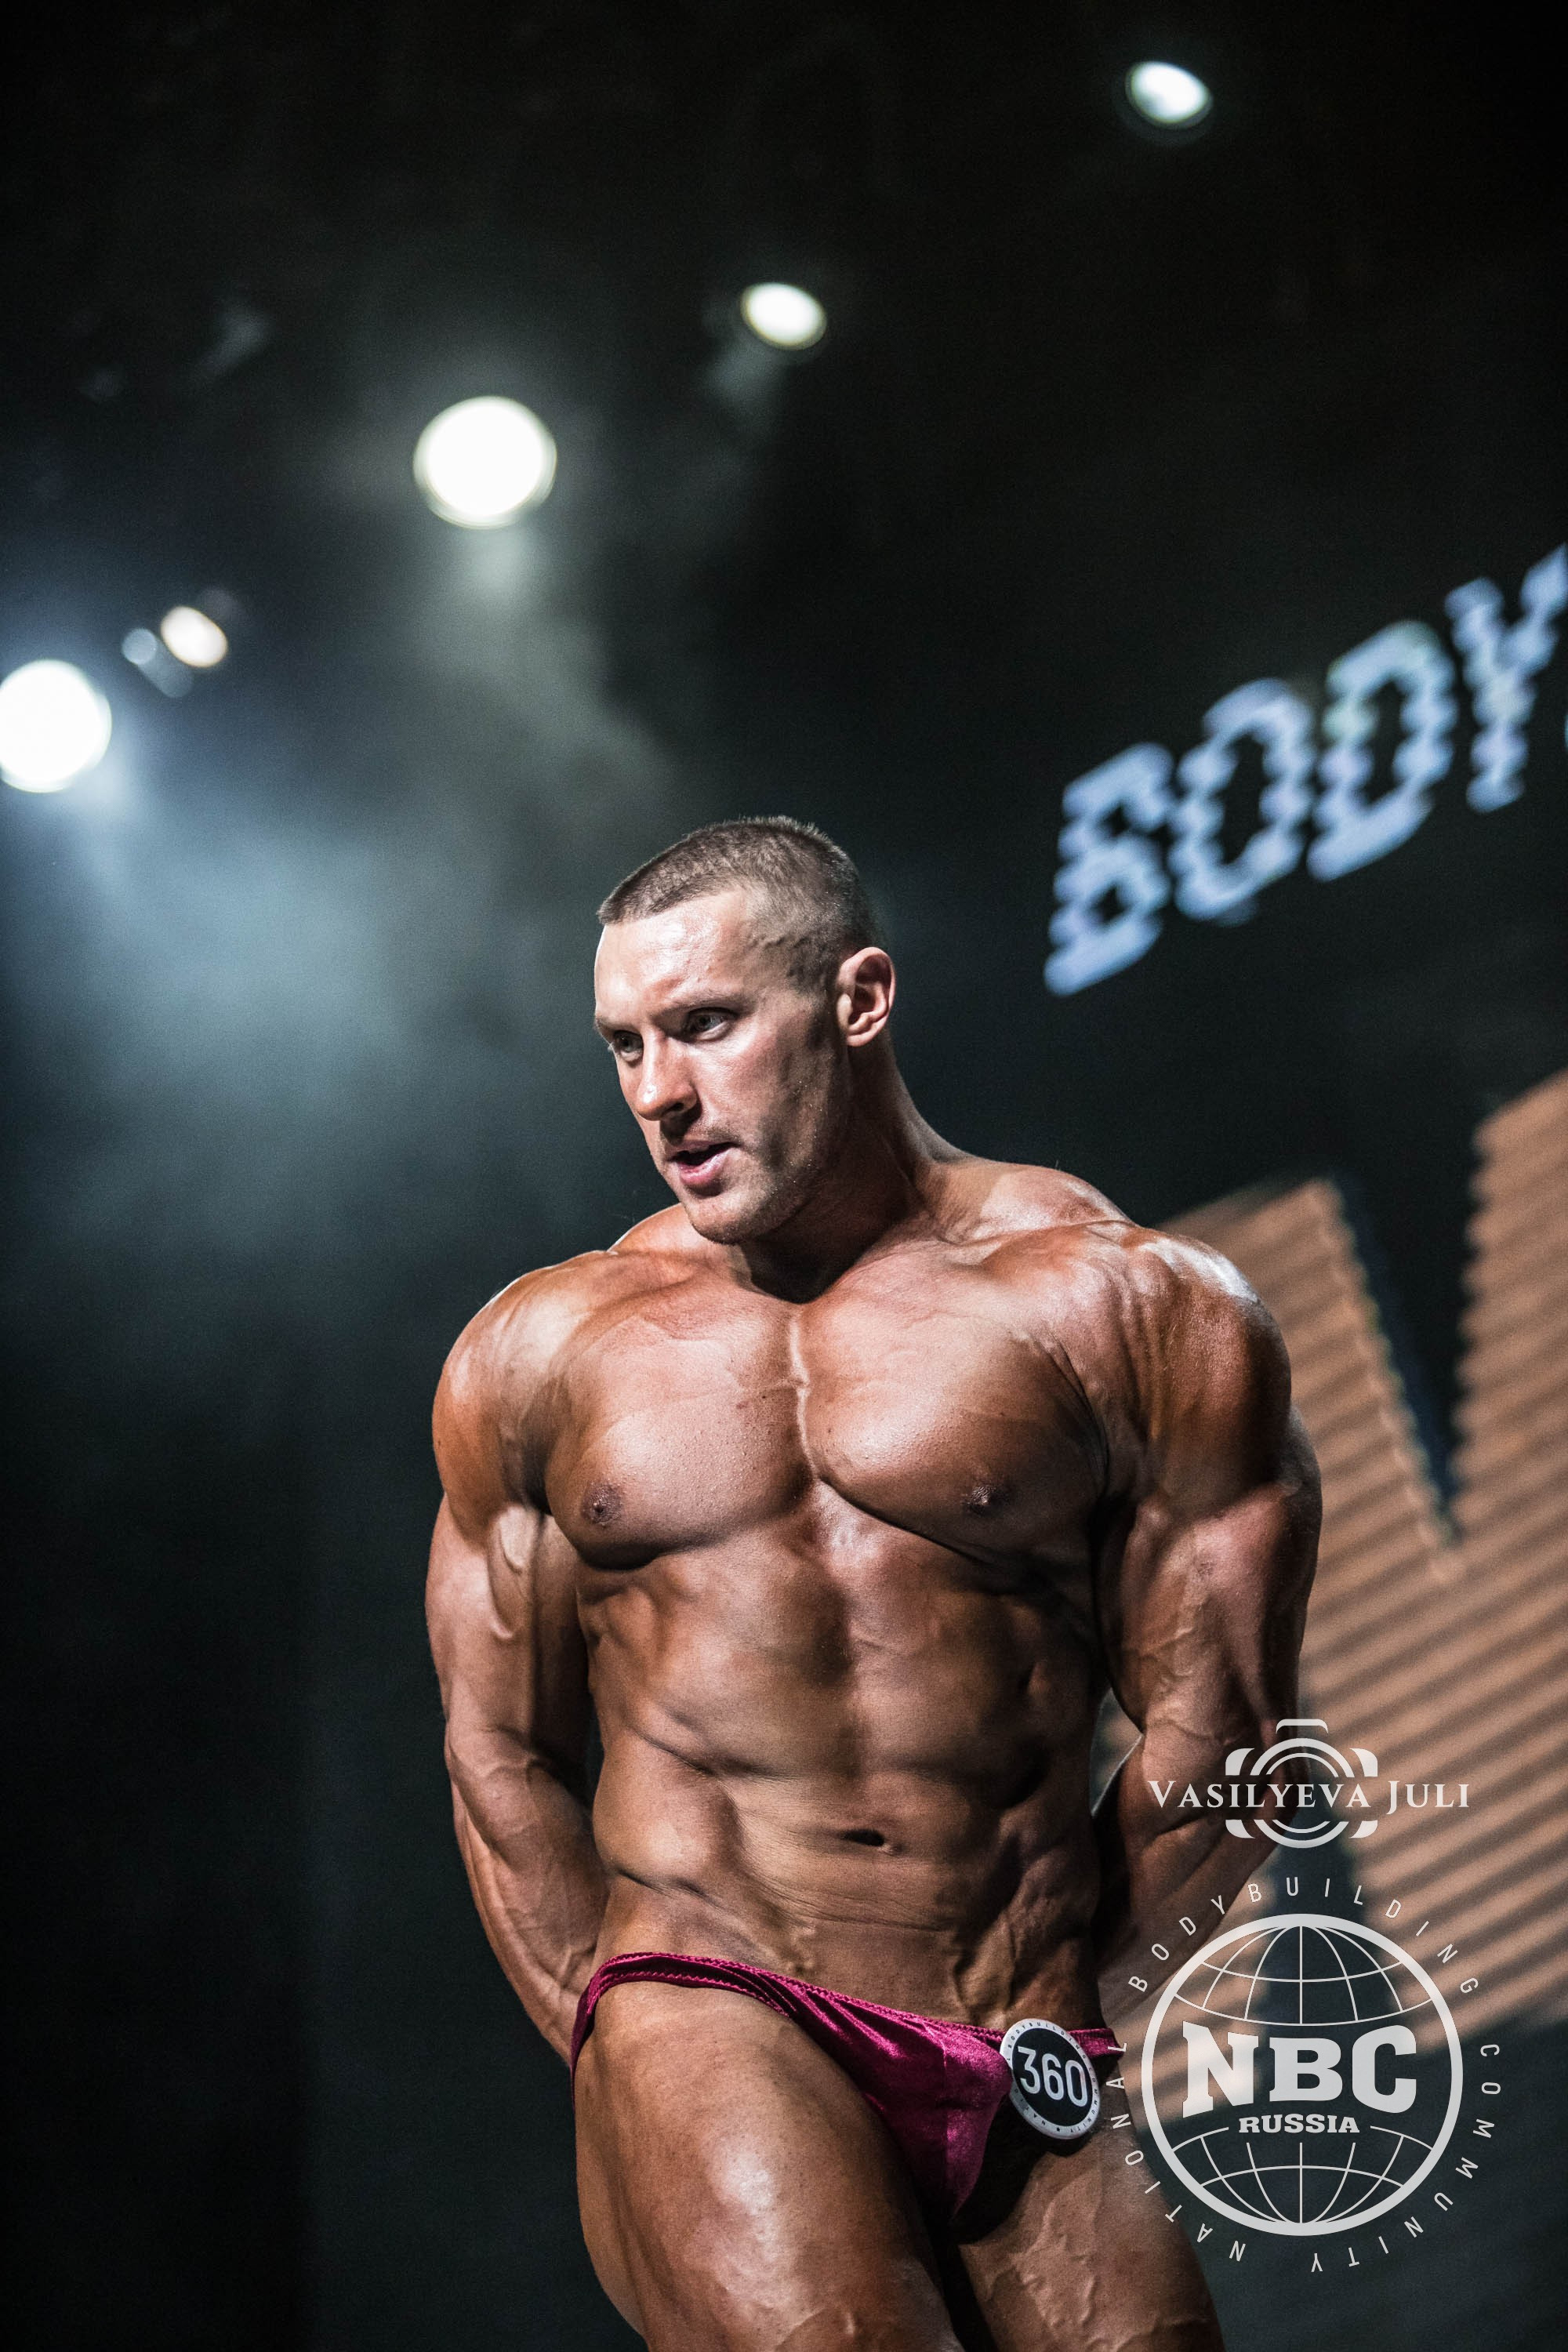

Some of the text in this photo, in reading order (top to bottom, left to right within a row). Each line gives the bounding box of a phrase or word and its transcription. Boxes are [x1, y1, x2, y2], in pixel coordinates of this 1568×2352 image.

[1044, 543, 1568, 996] BODY
[1007, 2021, 1087, 2060] BODYBUILDING
[1069, 2067, 1098, 2133] COMMUNITY
[1018, 2045, 1088, 2107] 360
